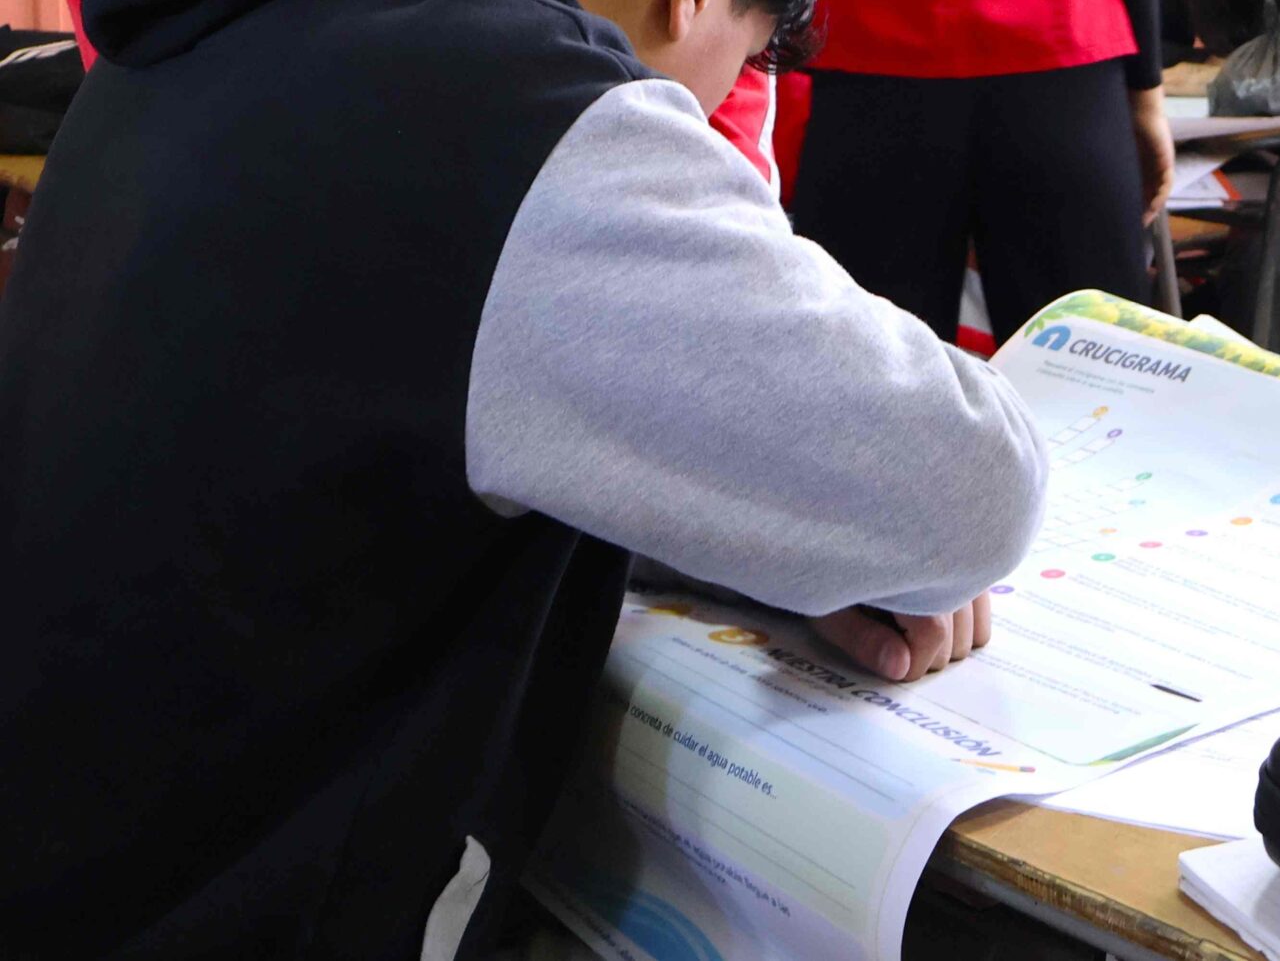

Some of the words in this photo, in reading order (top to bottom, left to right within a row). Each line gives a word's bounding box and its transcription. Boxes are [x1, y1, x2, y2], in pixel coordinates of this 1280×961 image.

[1069, 338, 1192, 383] CRUCIGRAMA
[766, 647, 856, 689] NUESTRA
[851, 689, 1002, 758] CONCLUSIÓN
[630, 705, 662, 732] concreta
[662, 723, 674, 737] de
[673, 729, 699, 752] cuidar
[698, 744, 709, 758] el
[706, 750, 729, 770] agua
[727, 761, 761, 789] potable
